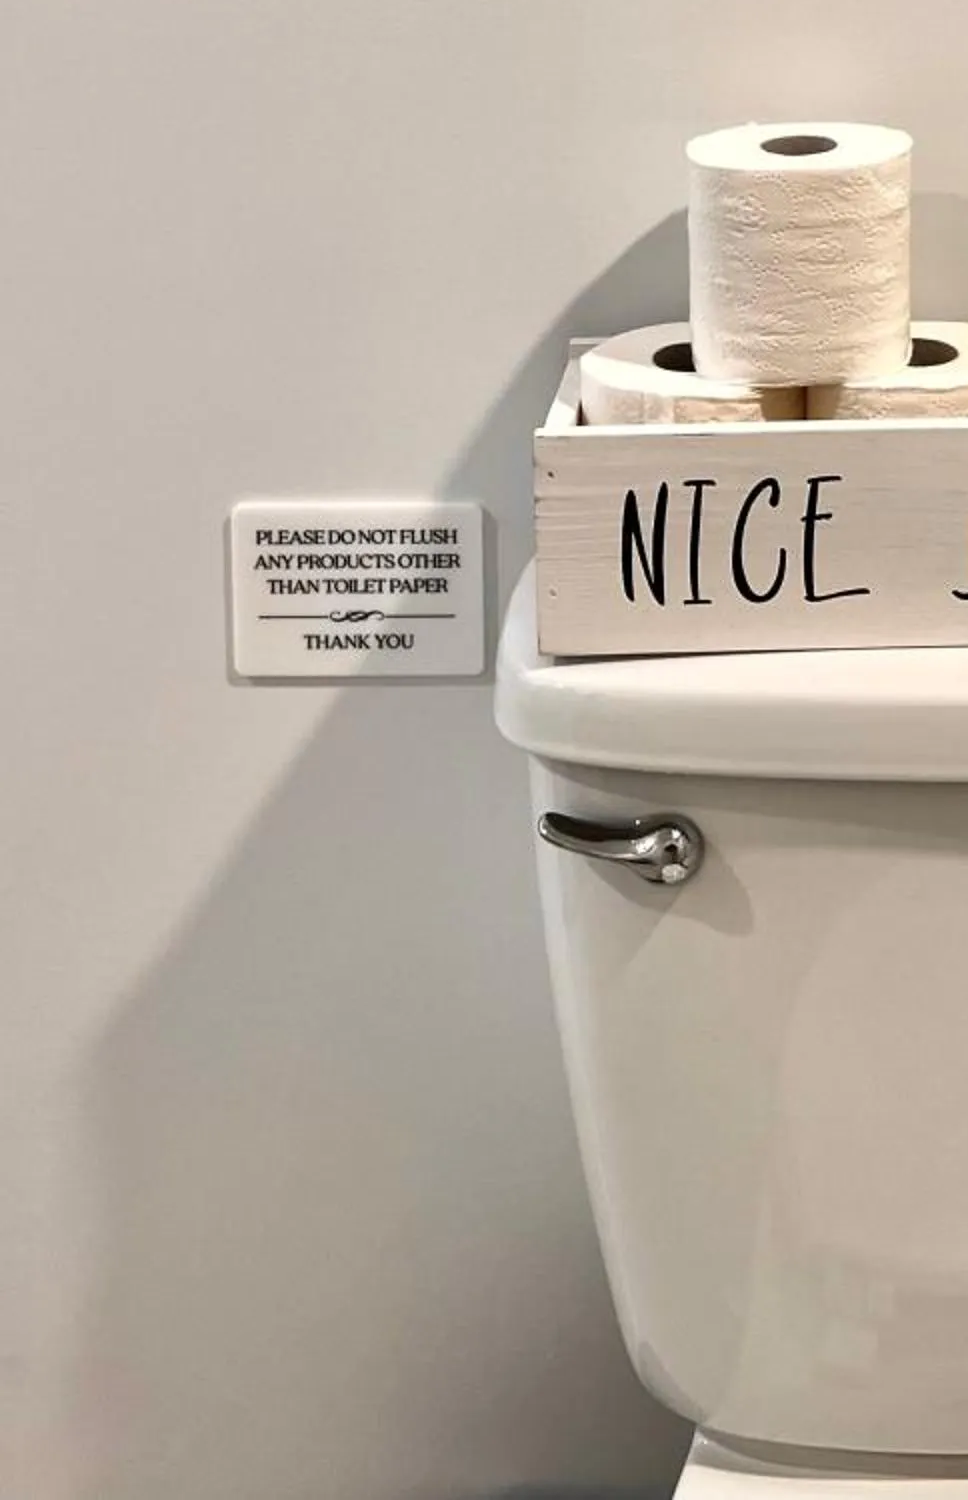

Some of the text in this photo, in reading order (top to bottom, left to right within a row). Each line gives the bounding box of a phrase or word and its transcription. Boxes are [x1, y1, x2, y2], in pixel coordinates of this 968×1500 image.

[255, 529, 458, 545] PLEASE DO NOT FLUSH
[621, 475, 871, 605] NICE
[254, 553, 461, 570] ANY PRODUCTS OTHER
[266, 577, 449, 595] THAN TOILET PAPER
[303, 633, 415, 650] THANK YOU
